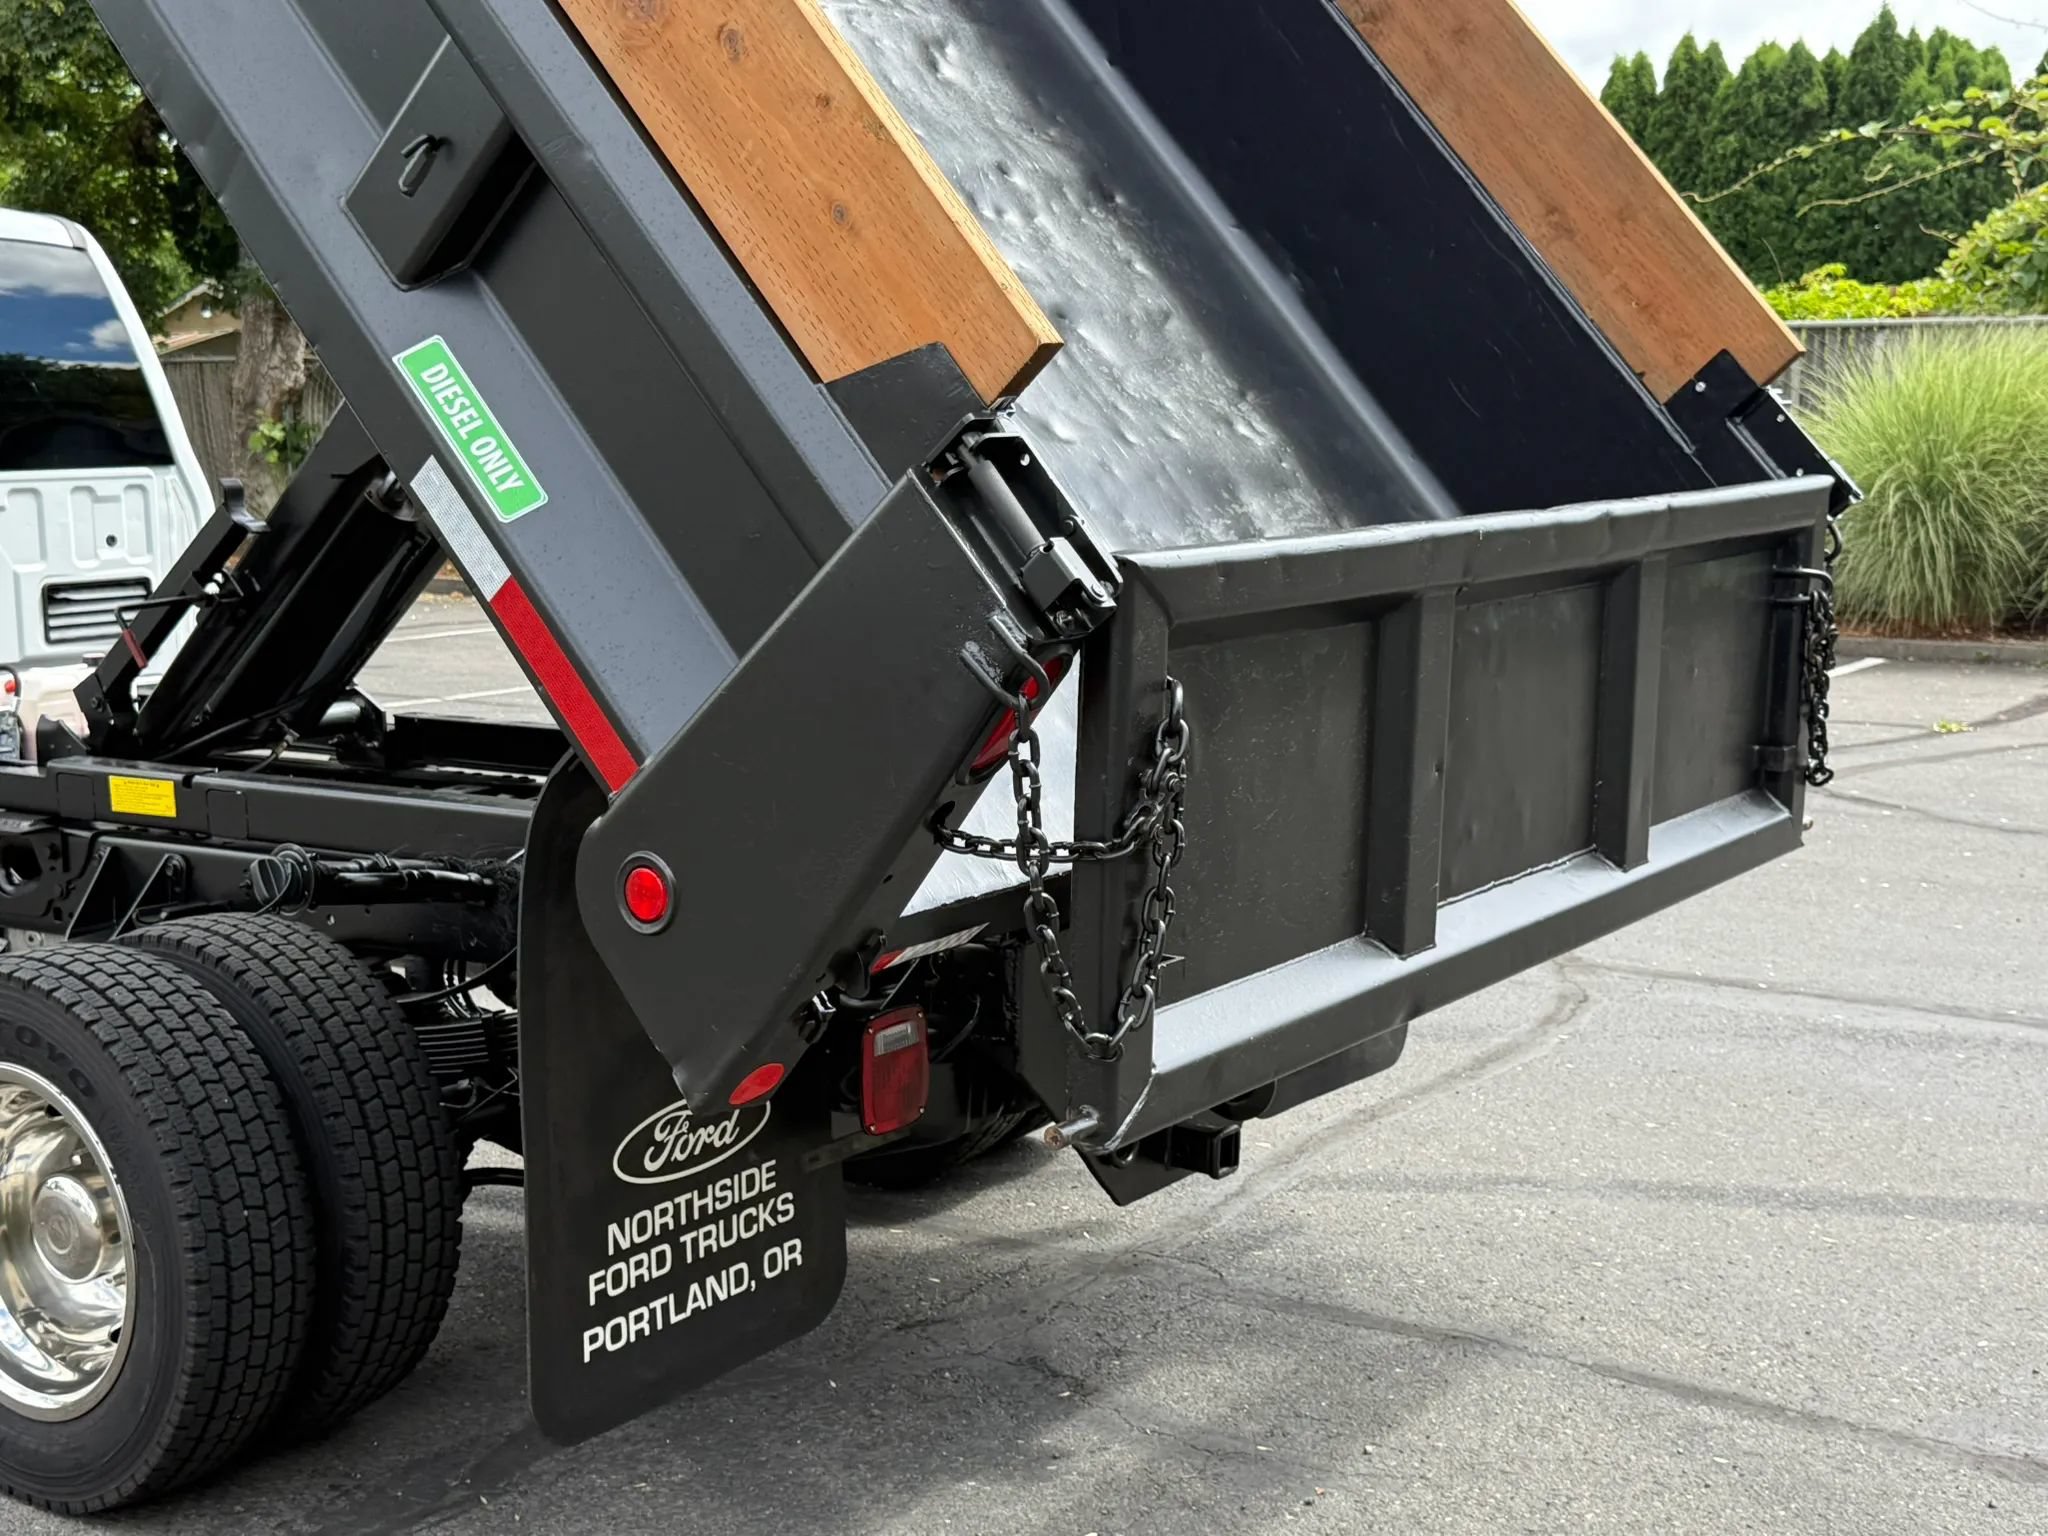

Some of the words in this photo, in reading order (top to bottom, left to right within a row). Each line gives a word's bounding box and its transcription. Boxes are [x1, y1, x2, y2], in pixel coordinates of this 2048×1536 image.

[420, 362, 484, 440] DIESEL
[469, 436, 525, 493] ONLY
[0, 1017, 97, 1097] OYO
[644, 1109, 740, 1172] Ford
[588, 1243, 672, 1306] FORD
[680, 1191, 795, 1264] TRUCKS
[607, 1159, 777, 1256] NORTHSIDE
[583, 1262, 756, 1363] PORTLAND,
[763, 1238, 802, 1279] OR
